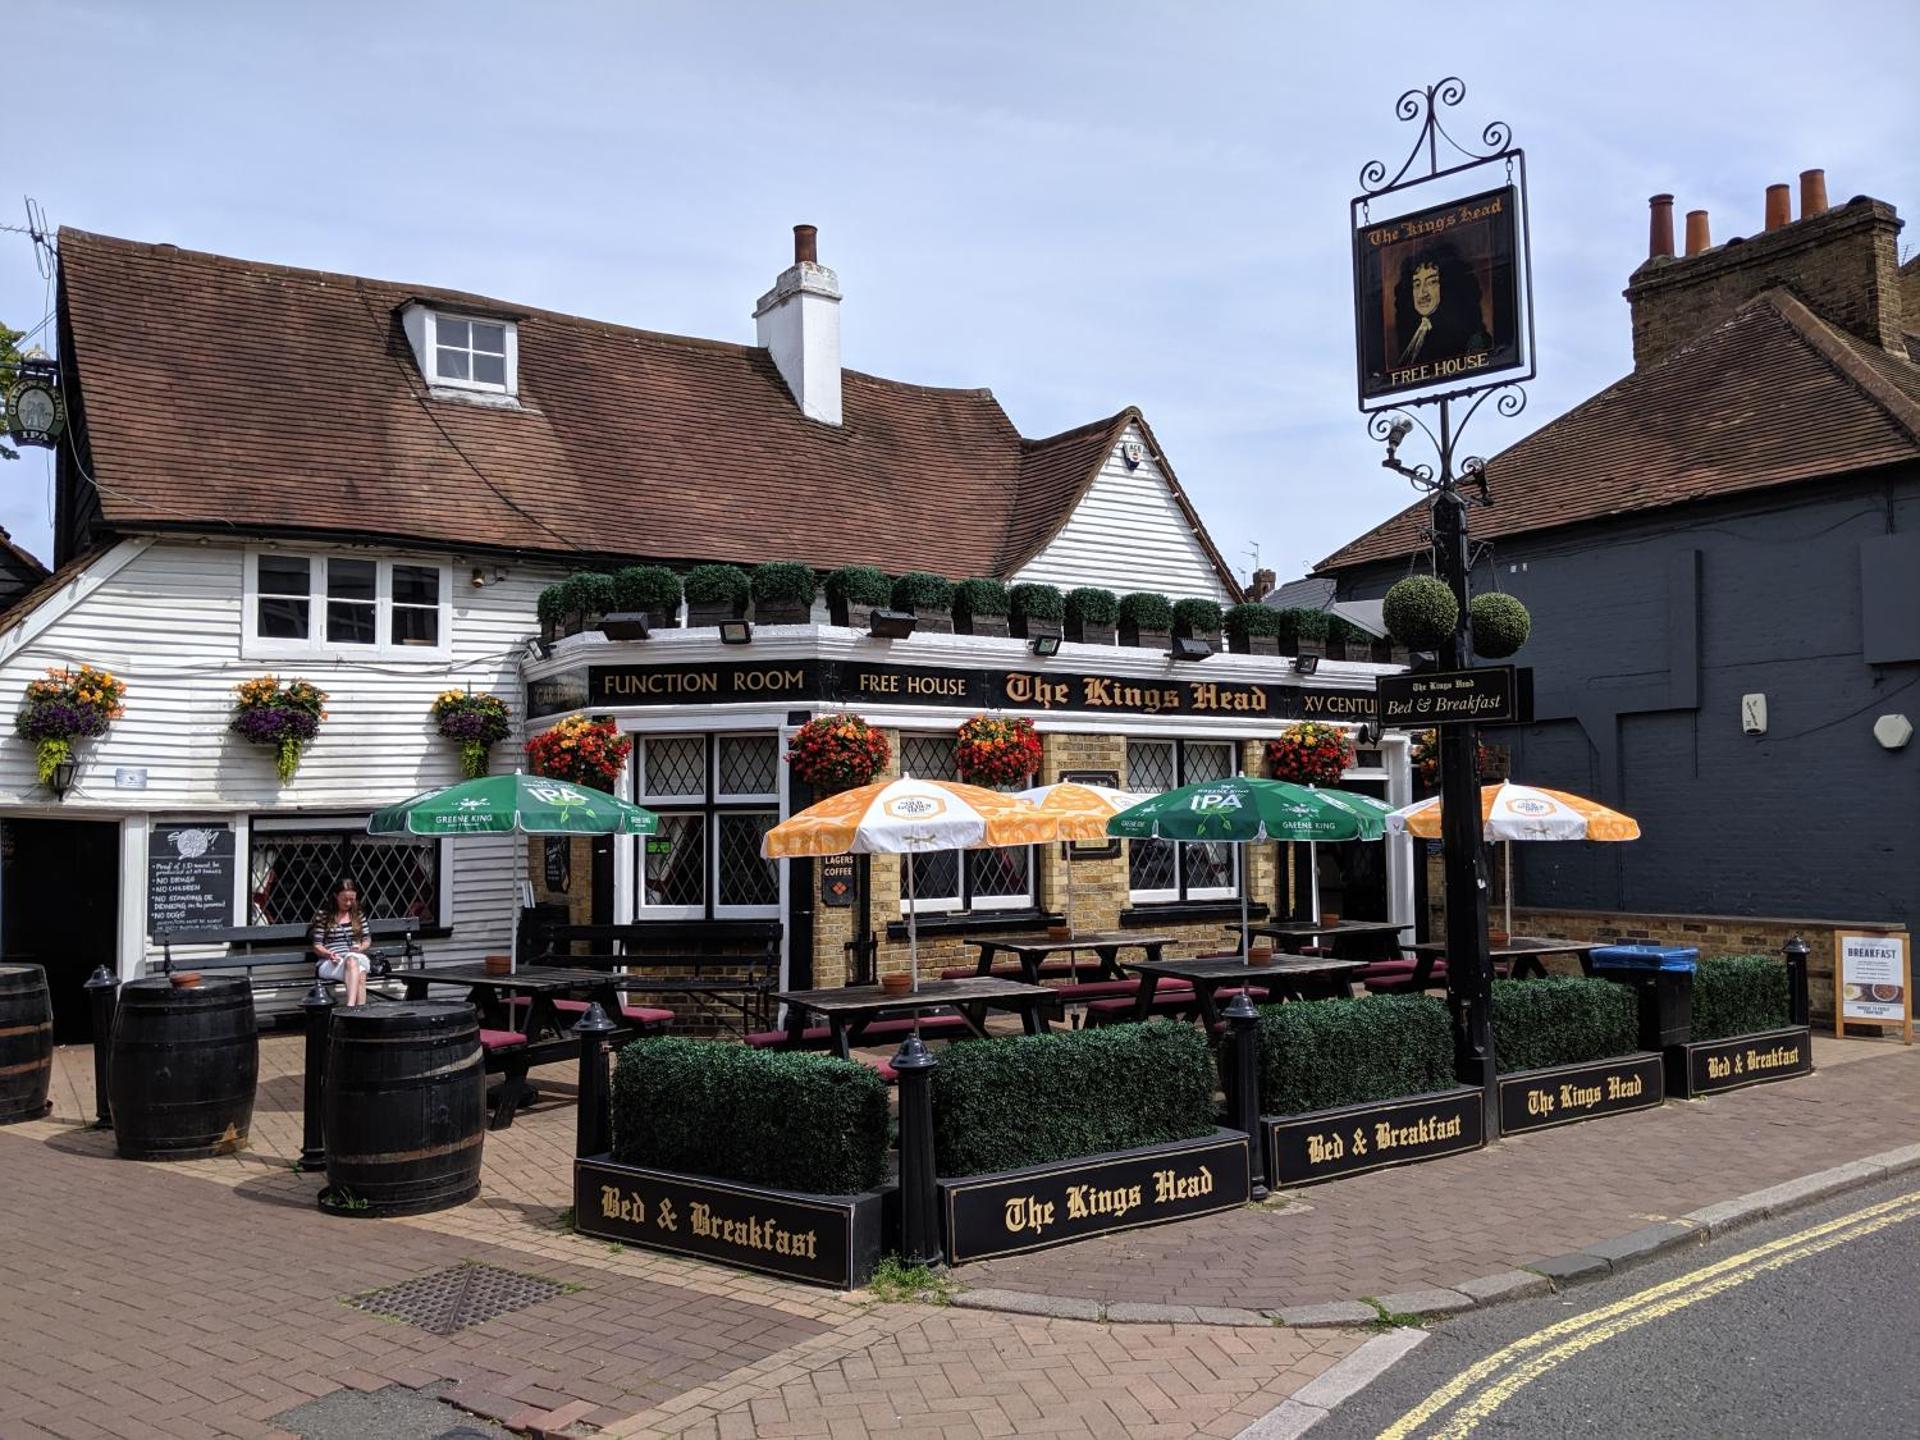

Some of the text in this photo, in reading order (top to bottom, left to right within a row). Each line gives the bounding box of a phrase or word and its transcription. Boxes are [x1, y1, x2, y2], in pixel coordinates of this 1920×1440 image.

[1367, 229, 1398, 246] The
[1391, 353, 1490, 386] FREE HOUSE
[22, 431, 48, 441] IPA
[604, 672, 718, 694] FUNCTION
[733, 670, 804, 690] ROOM
[860, 674, 966, 696] FREE HOUSE
[1412, 682, 1427, 692] The
[1006, 672, 1267, 713] The Kings Head
[1304, 695, 1325, 711] XV
[1387, 694, 1501, 715] Bed & Breakfast
[527, 787, 591, 804] IPA
[1190, 794, 1243, 811] IPA
[435, 814, 493, 824] GREENE KING
[1282, 821, 1336, 830] GREENE KING
[825, 856, 854, 865] LAGERS
[824, 867, 852, 877] COFFEE
[156, 884, 200, 893] NO CHILDREN
[155, 902, 186, 910] DRINKING
[169, 894, 202, 902] STANDING
[166, 911, 186, 919] DOGS
[1847, 947, 1897, 959] BREAKFAST
[1708, 1046, 1799, 1079] Bed & Breakfast
[1527, 1074, 1642, 1118] The Kings Head
[1306, 1114, 1462, 1164] Bed & Breakfast
[1005, 1165, 1214, 1236] The Kings Head
[601, 1185, 818, 1260] Bed & Breakfast
